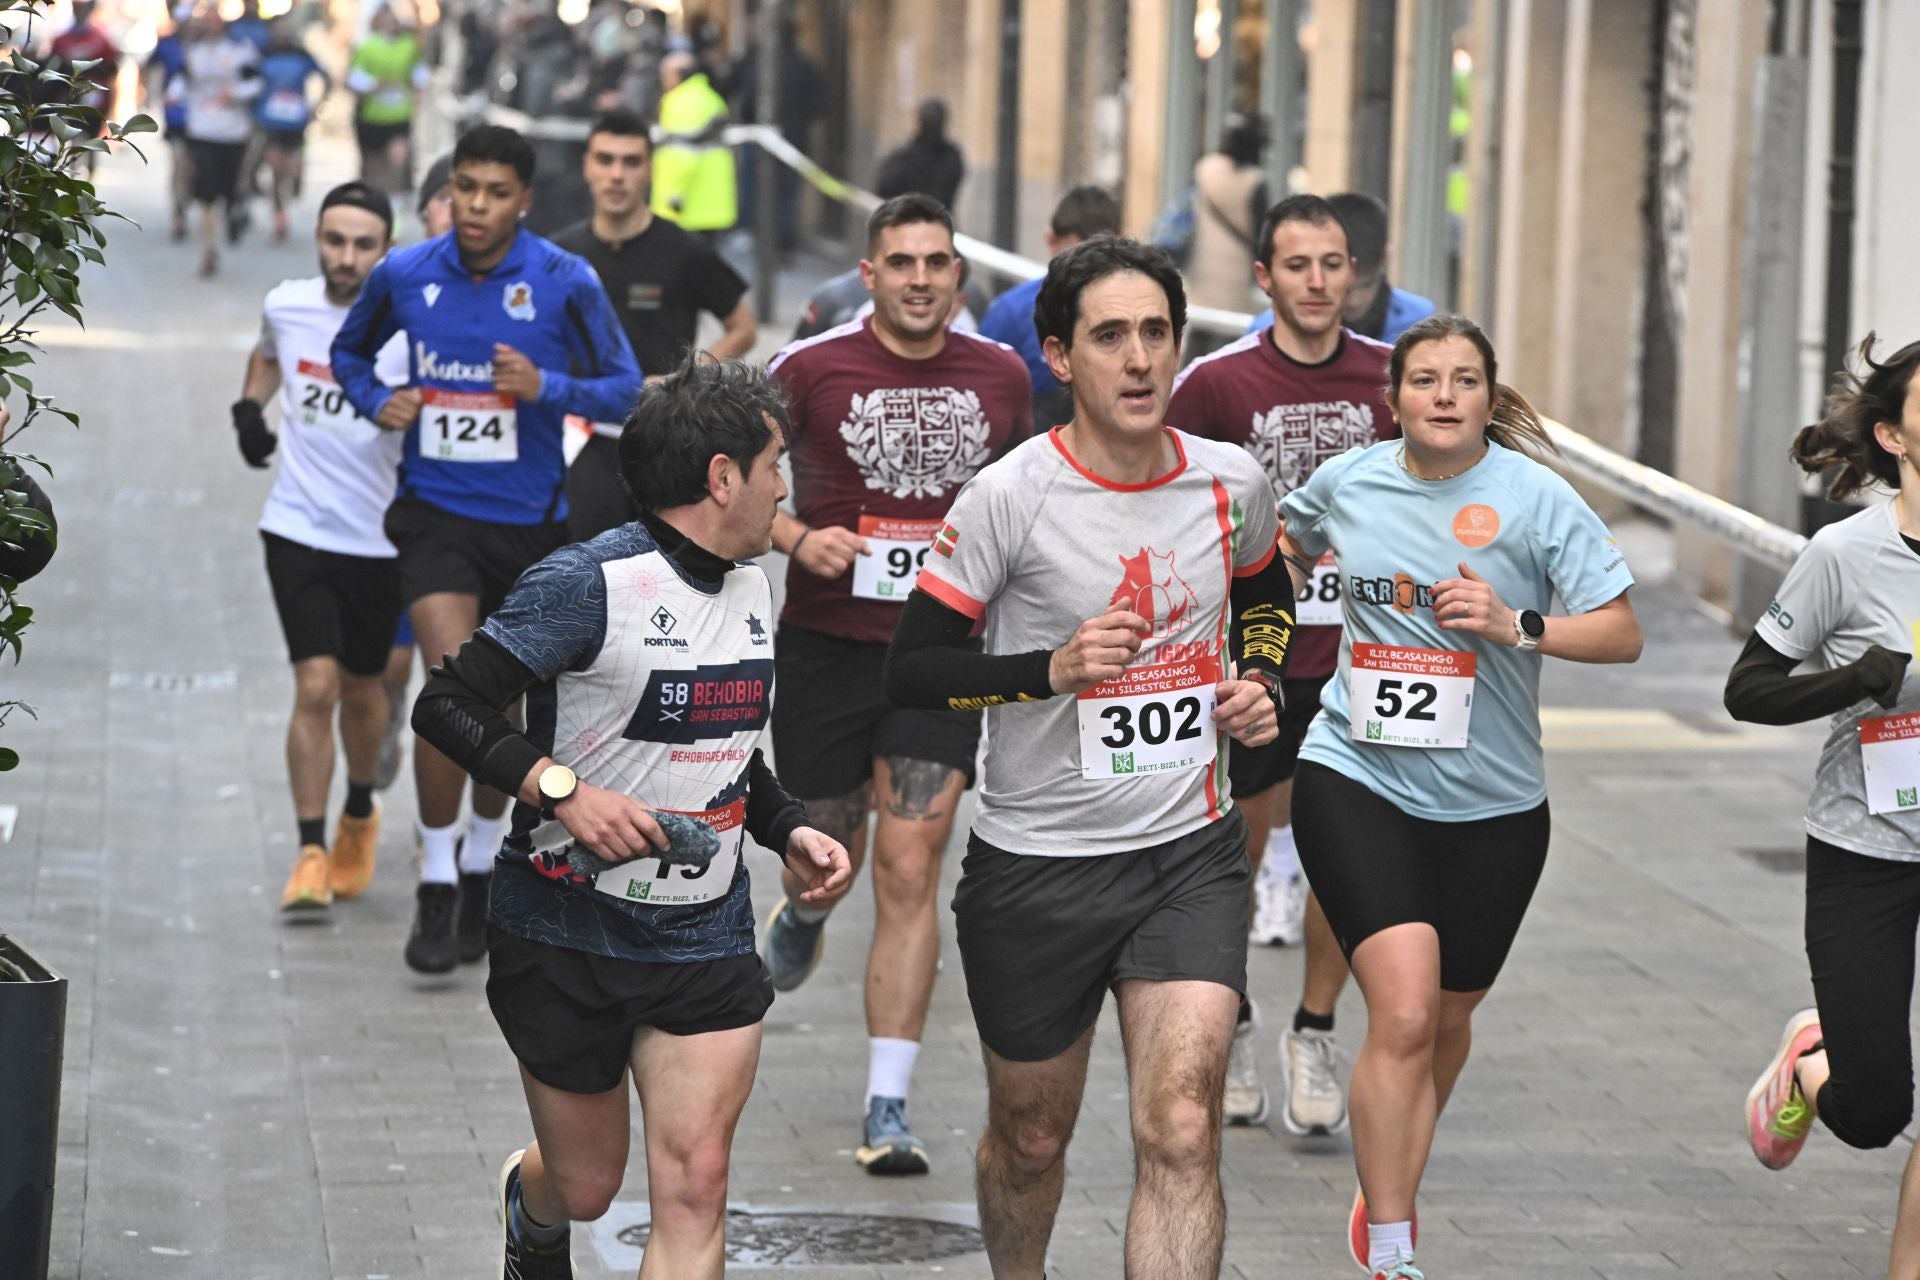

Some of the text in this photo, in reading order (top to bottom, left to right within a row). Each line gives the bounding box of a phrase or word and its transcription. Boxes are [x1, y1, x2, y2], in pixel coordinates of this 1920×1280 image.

[303, 384, 359, 419] 20
[434, 414, 504, 442] 124
[1351, 574, 1438, 609] ERRON
[644, 637, 689, 647] FORTUNA
[1363, 659, 1460, 675] SAN SILBESTRE KROSA
[660, 682, 689, 705] 58
[693, 679, 764, 706] BEHOBIA
[1095, 676, 1202, 697] SAN SILBESTRE KROSA
[1374, 678, 1438, 721] 52
[690, 706, 761, 722] SAN SEBASTIAN
[1100, 696, 1202, 749] 302
[1877, 731, 1896, 740] SAN
[670, 748, 746, 763] BEHOBIAREN BILA
[1137, 757, 1196, 773] BETI-BIZI, K. E.
